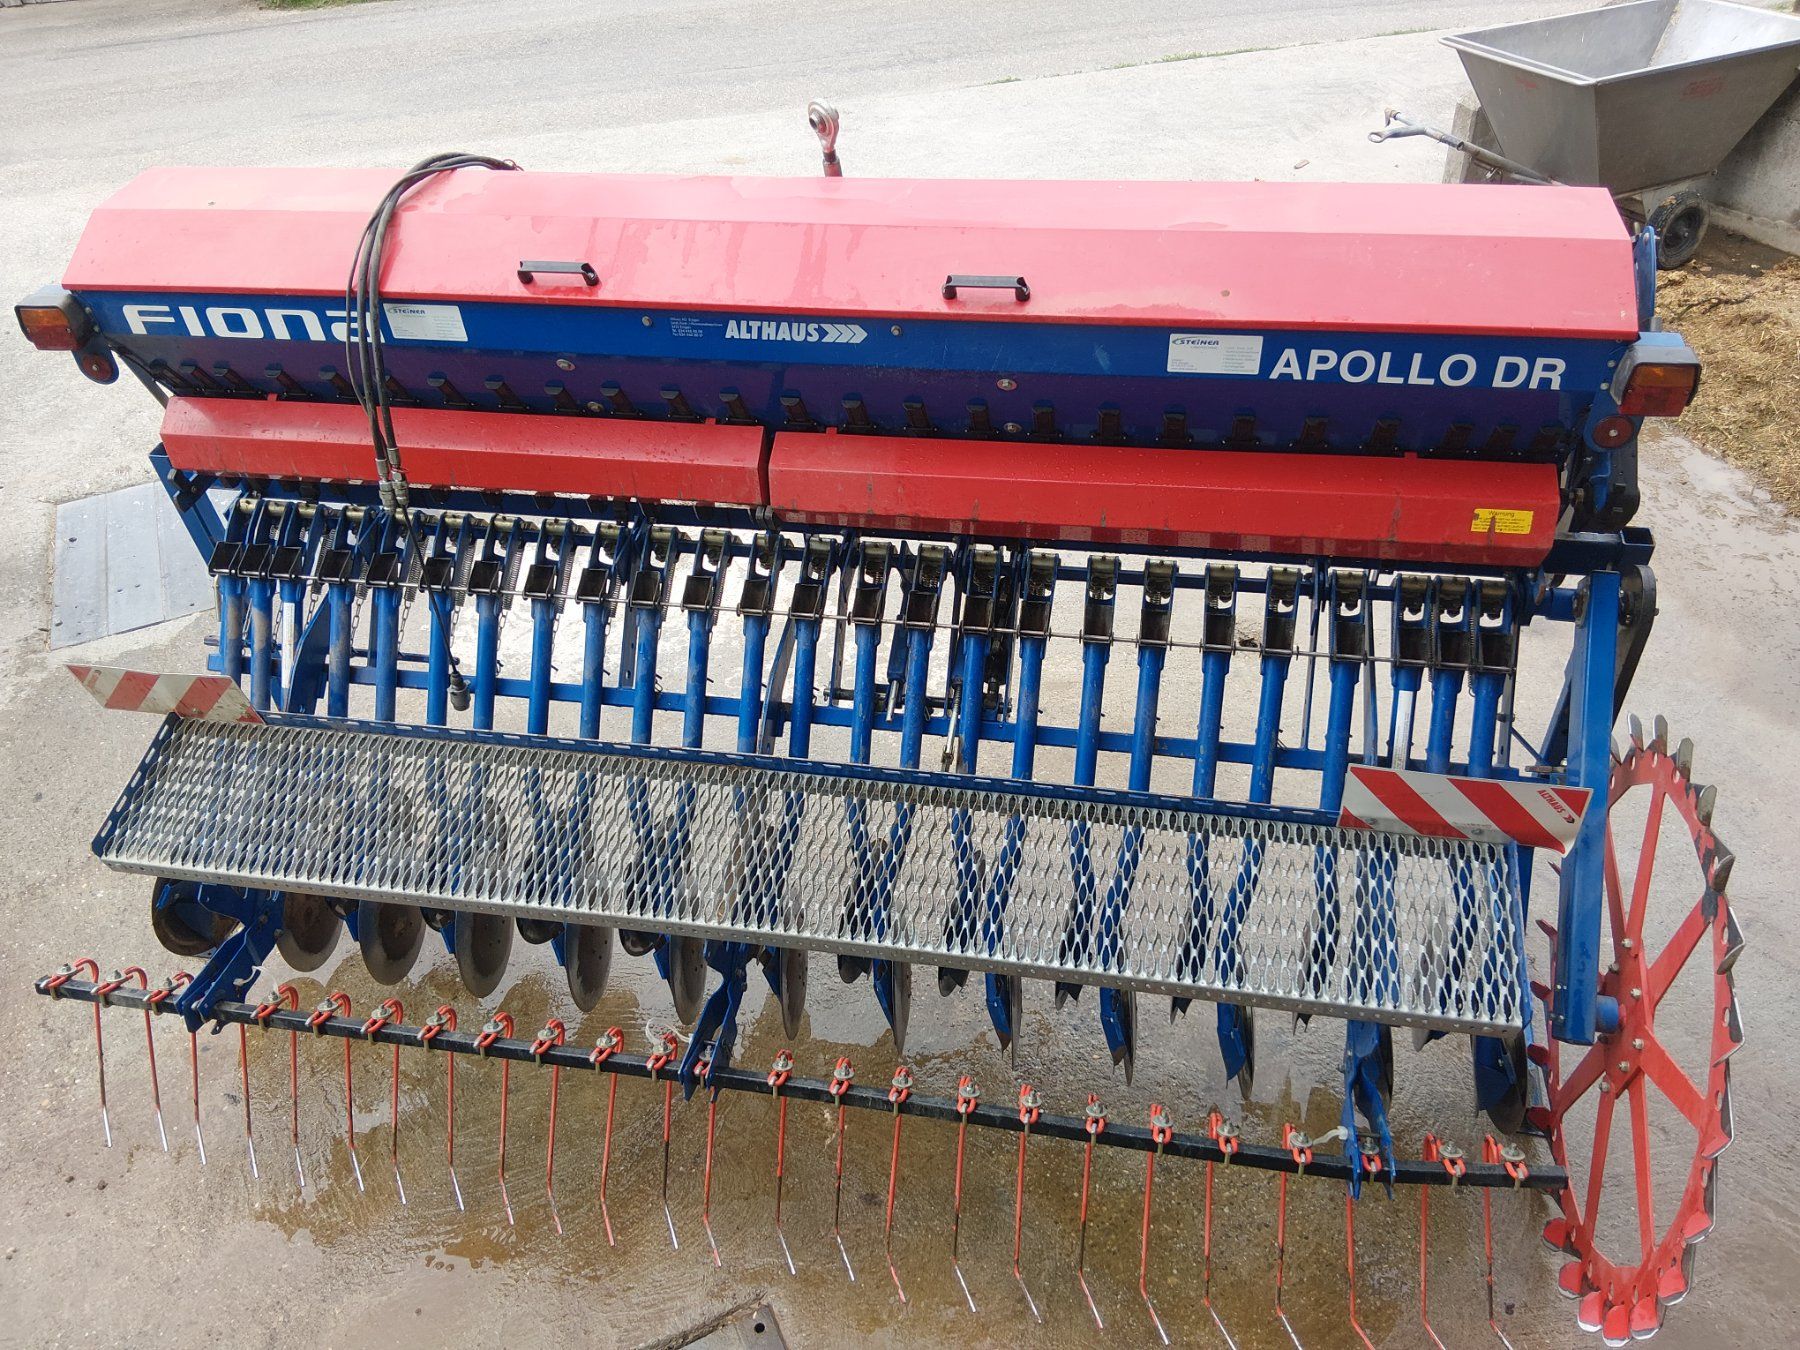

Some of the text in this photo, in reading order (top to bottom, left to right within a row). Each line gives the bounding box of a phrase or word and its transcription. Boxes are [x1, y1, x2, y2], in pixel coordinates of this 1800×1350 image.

[725, 320, 819, 342] ALTHAUS
[1269, 348, 1477, 387] APOLLO
[1492, 356, 1566, 390] DR
[1537, 789, 1566, 813] ALTHAUS
